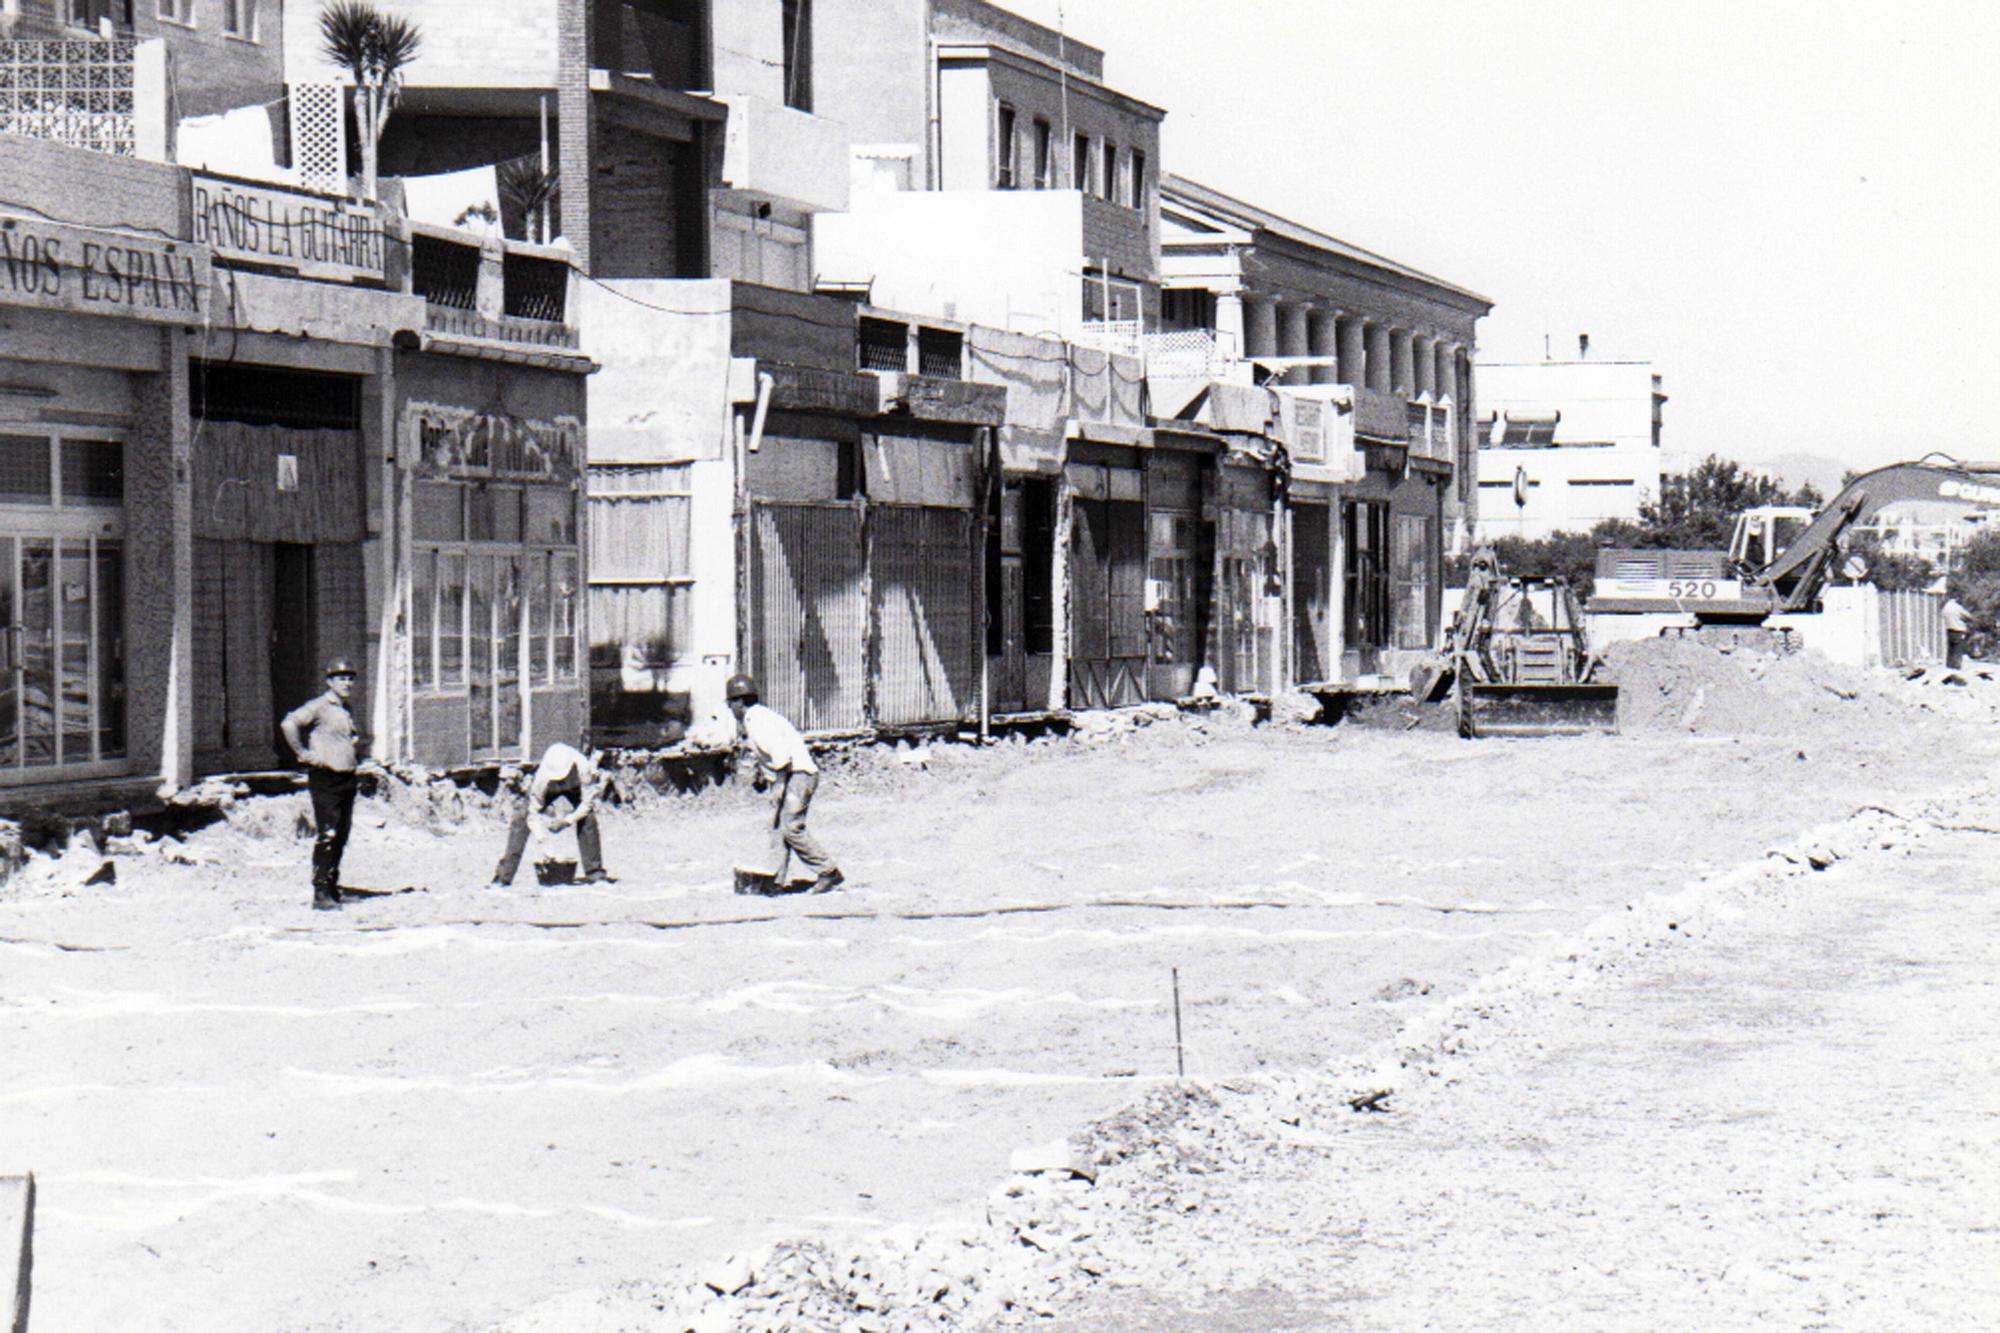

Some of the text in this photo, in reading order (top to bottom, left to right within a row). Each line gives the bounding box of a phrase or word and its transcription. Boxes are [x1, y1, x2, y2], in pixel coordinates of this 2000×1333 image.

[195, 186, 383, 271] BAÑOS LA GUITARRA
[1668, 581, 1717, 599] 520
